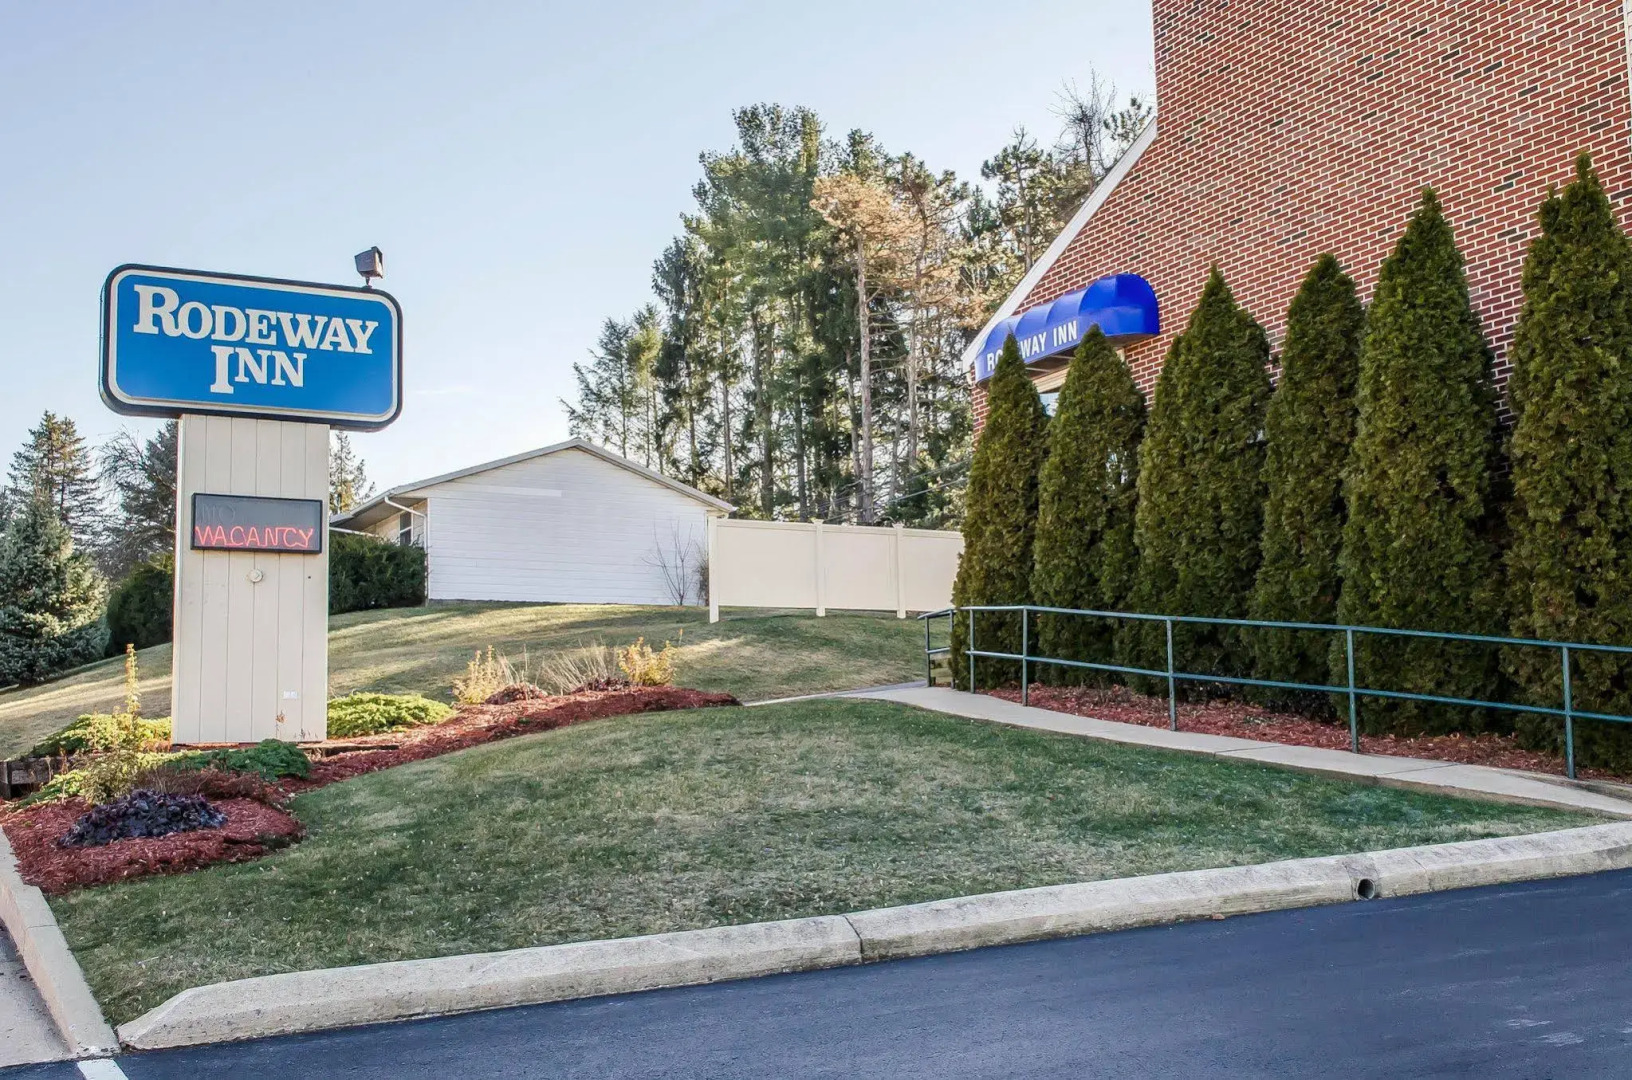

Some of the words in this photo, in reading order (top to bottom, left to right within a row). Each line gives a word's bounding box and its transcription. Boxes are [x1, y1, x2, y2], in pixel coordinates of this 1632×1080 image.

[133, 284, 379, 355] RODEWAY
[210, 345, 307, 394] INN
[987, 331, 1047, 372] ROWAY
[1053, 320, 1078, 347] INN
[195, 525, 314, 548] VACANCY
